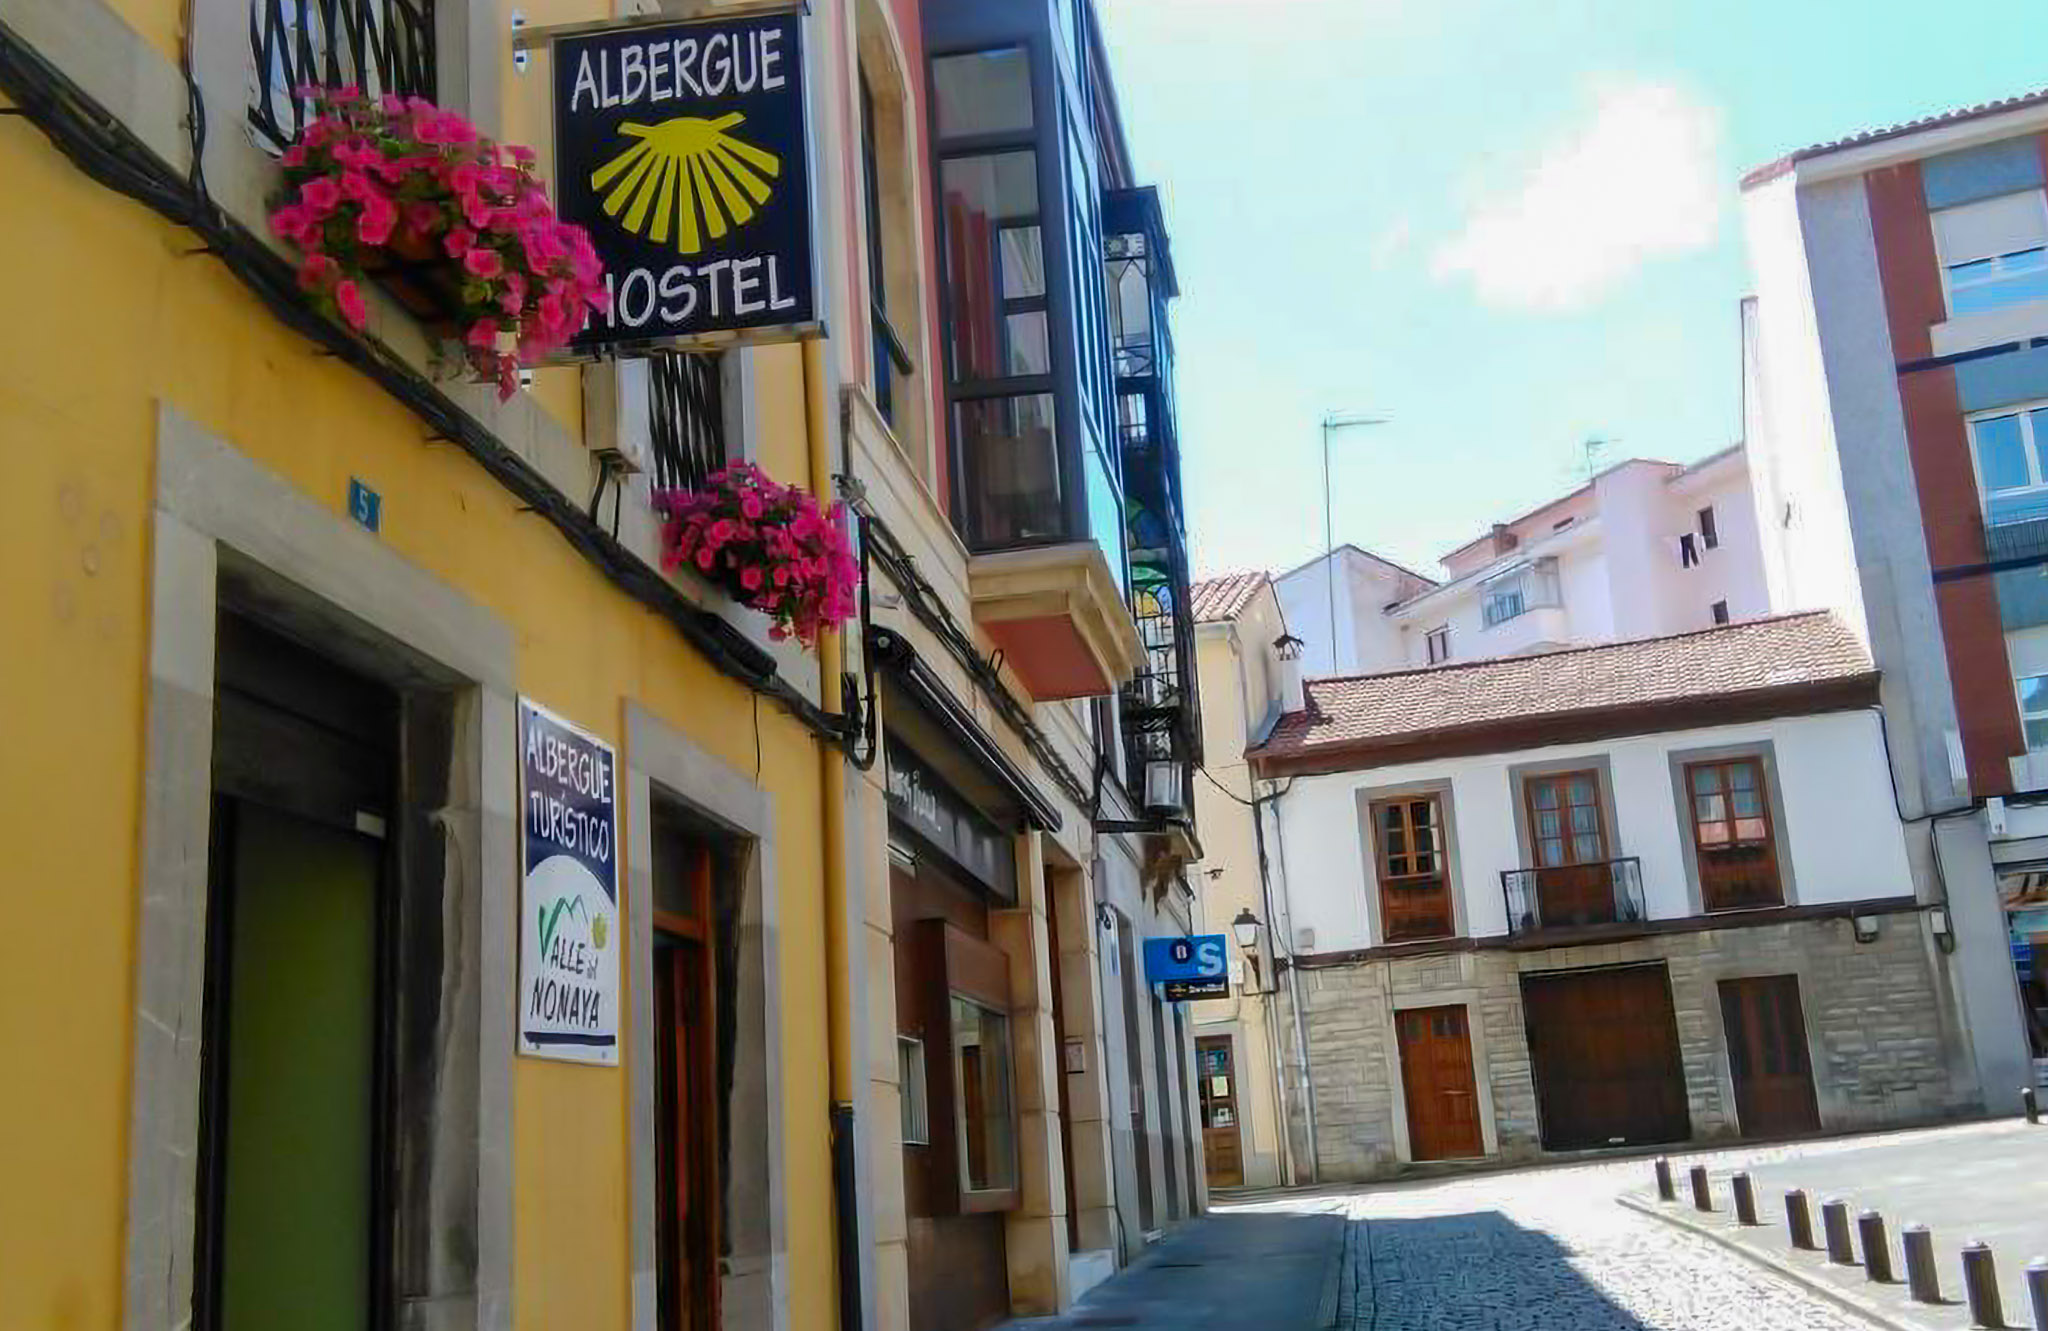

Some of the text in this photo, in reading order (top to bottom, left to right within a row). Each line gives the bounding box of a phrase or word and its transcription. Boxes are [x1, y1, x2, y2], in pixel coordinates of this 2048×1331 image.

[572, 29, 785, 111] ALBERGUE
[359, 489, 369, 522] 5
[527, 730, 611, 803] ALBERGUE
[530, 791, 609, 863] TURÍSTICO
[538, 899, 587, 974] VALLE
[1197, 942, 1223, 976] S
[530, 977, 600, 1029] NONAYA
